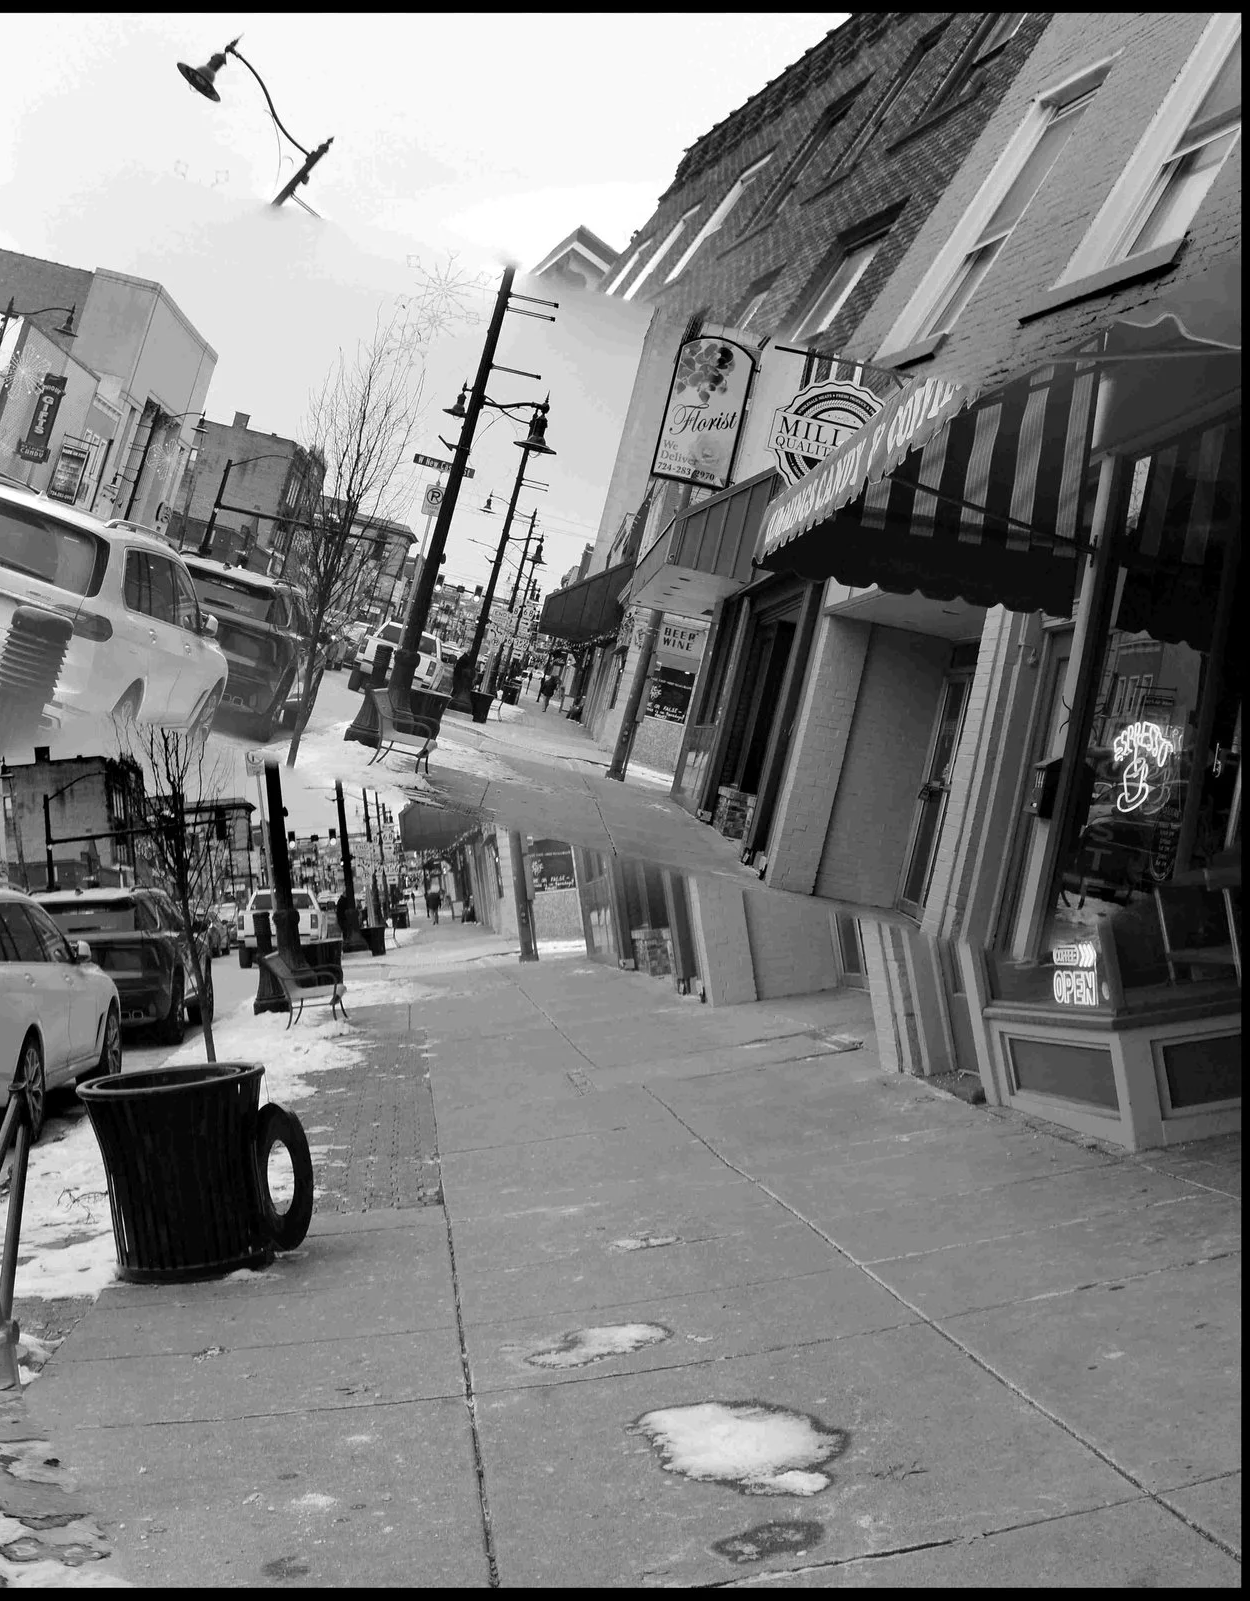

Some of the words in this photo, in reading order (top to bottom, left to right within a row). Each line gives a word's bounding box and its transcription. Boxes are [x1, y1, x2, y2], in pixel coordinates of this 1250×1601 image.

[34, 395, 55, 435] GIFTS
[669, 404, 737, 435] Florist
[663, 439, 678, 451] We
[425, 457, 439, 468] New
[662, 637, 693, 652] WINE
[1053, 969, 1096, 1006] OPEN
